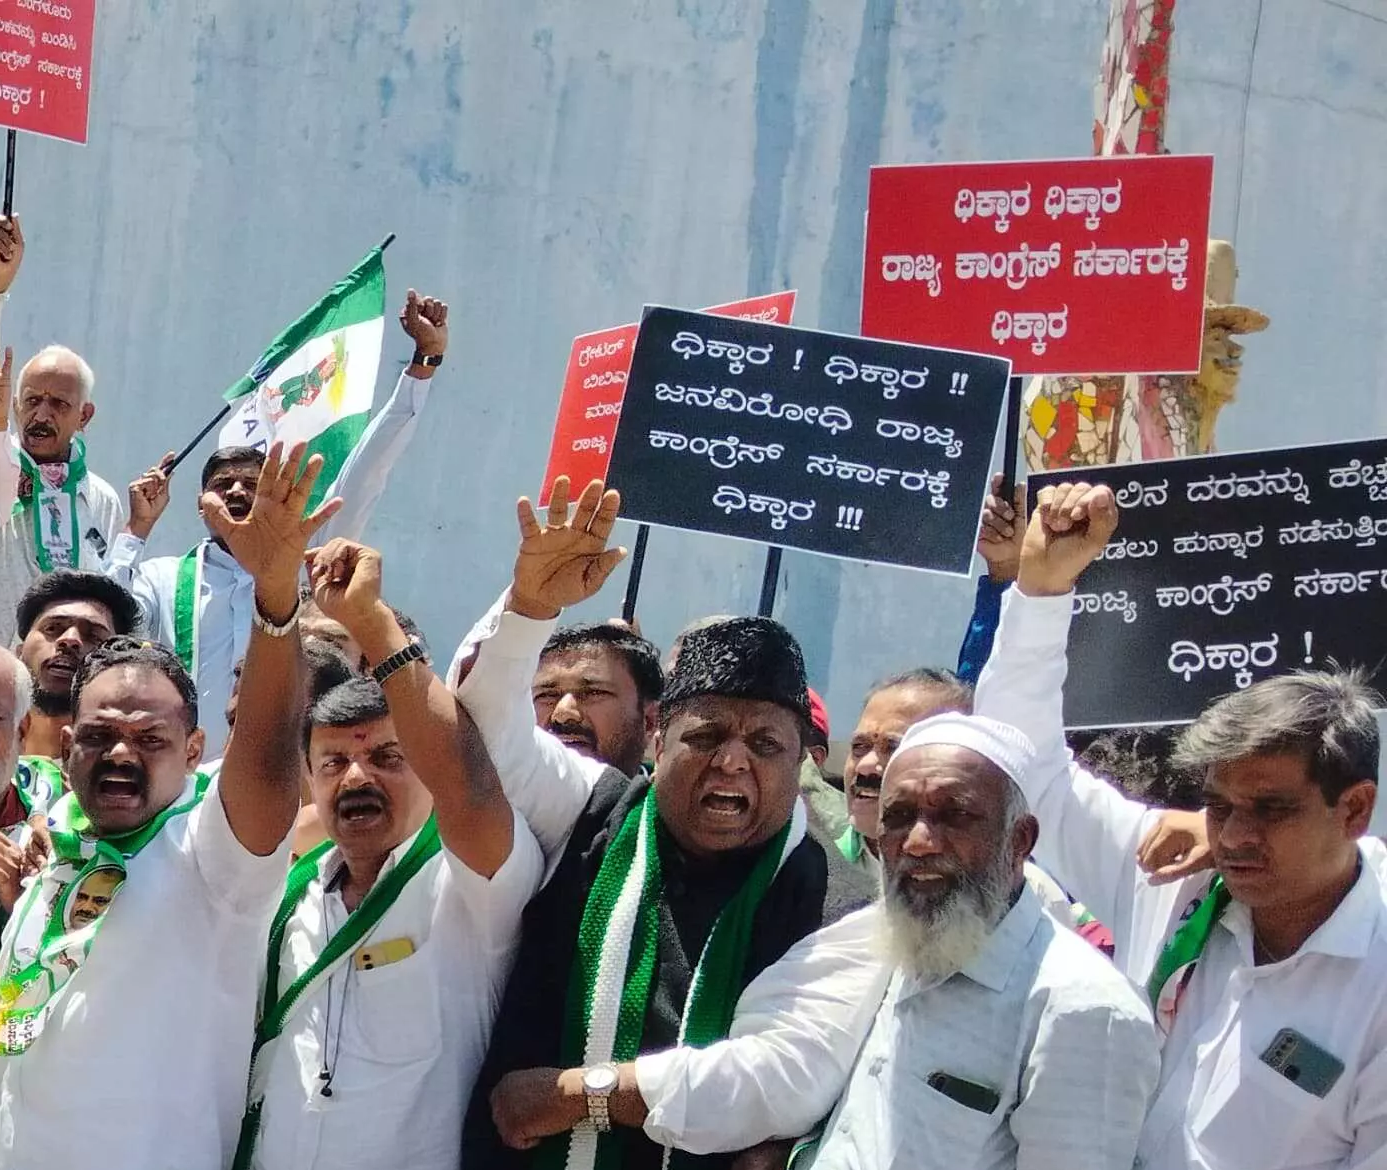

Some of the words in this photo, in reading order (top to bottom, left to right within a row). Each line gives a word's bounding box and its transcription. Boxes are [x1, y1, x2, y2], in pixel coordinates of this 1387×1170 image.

[955, 184, 1033, 236] ಧಿಕ್ಕಾರ
[1043, 178, 1123, 234] ಧಿಕ್ಕಾರ
[882, 251, 943, 298] ರಾಜ್ಯ
[955, 245, 1062, 291] ಕಾಂಗ್ರೆಸ್
[1073, 238, 1190, 292] ಸರ್ಕಾರಕ್ಕೆ
[991, 304, 1069, 359] ಧಿಕ್ಕಾರ
[671, 331, 774, 379] ಧಿಕ್ಕಾರ
[825, 352, 929, 402] ಧಿಕ್ಕಾರ
[654, 377, 854, 433] ಜನವಿರೋಧಿ
[877, 416, 965, 461] ರಾಜ್ಯ
[649, 426, 782, 480] ಕಾಂಗ್ರೆಸ್
[807, 453, 951, 511] ಸರ್ಕಾರಕ್ಕೆ
[1187, 468, 1310, 504] ದರವನ್ನು
[712, 482, 816, 534] ಧಿಕ್ಕಾರ
[837, 504, 863, 532] !!!
[1173, 526, 1264, 559] ಹುನ್ನಾರ
[1156, 573, 1273, 615] ಕಾಂಗ್ರೆಸ್
[1168, 633, 1279, 689] ಧಿಕ್ಕಾರ
[1304, 631, 1313, 664] !
